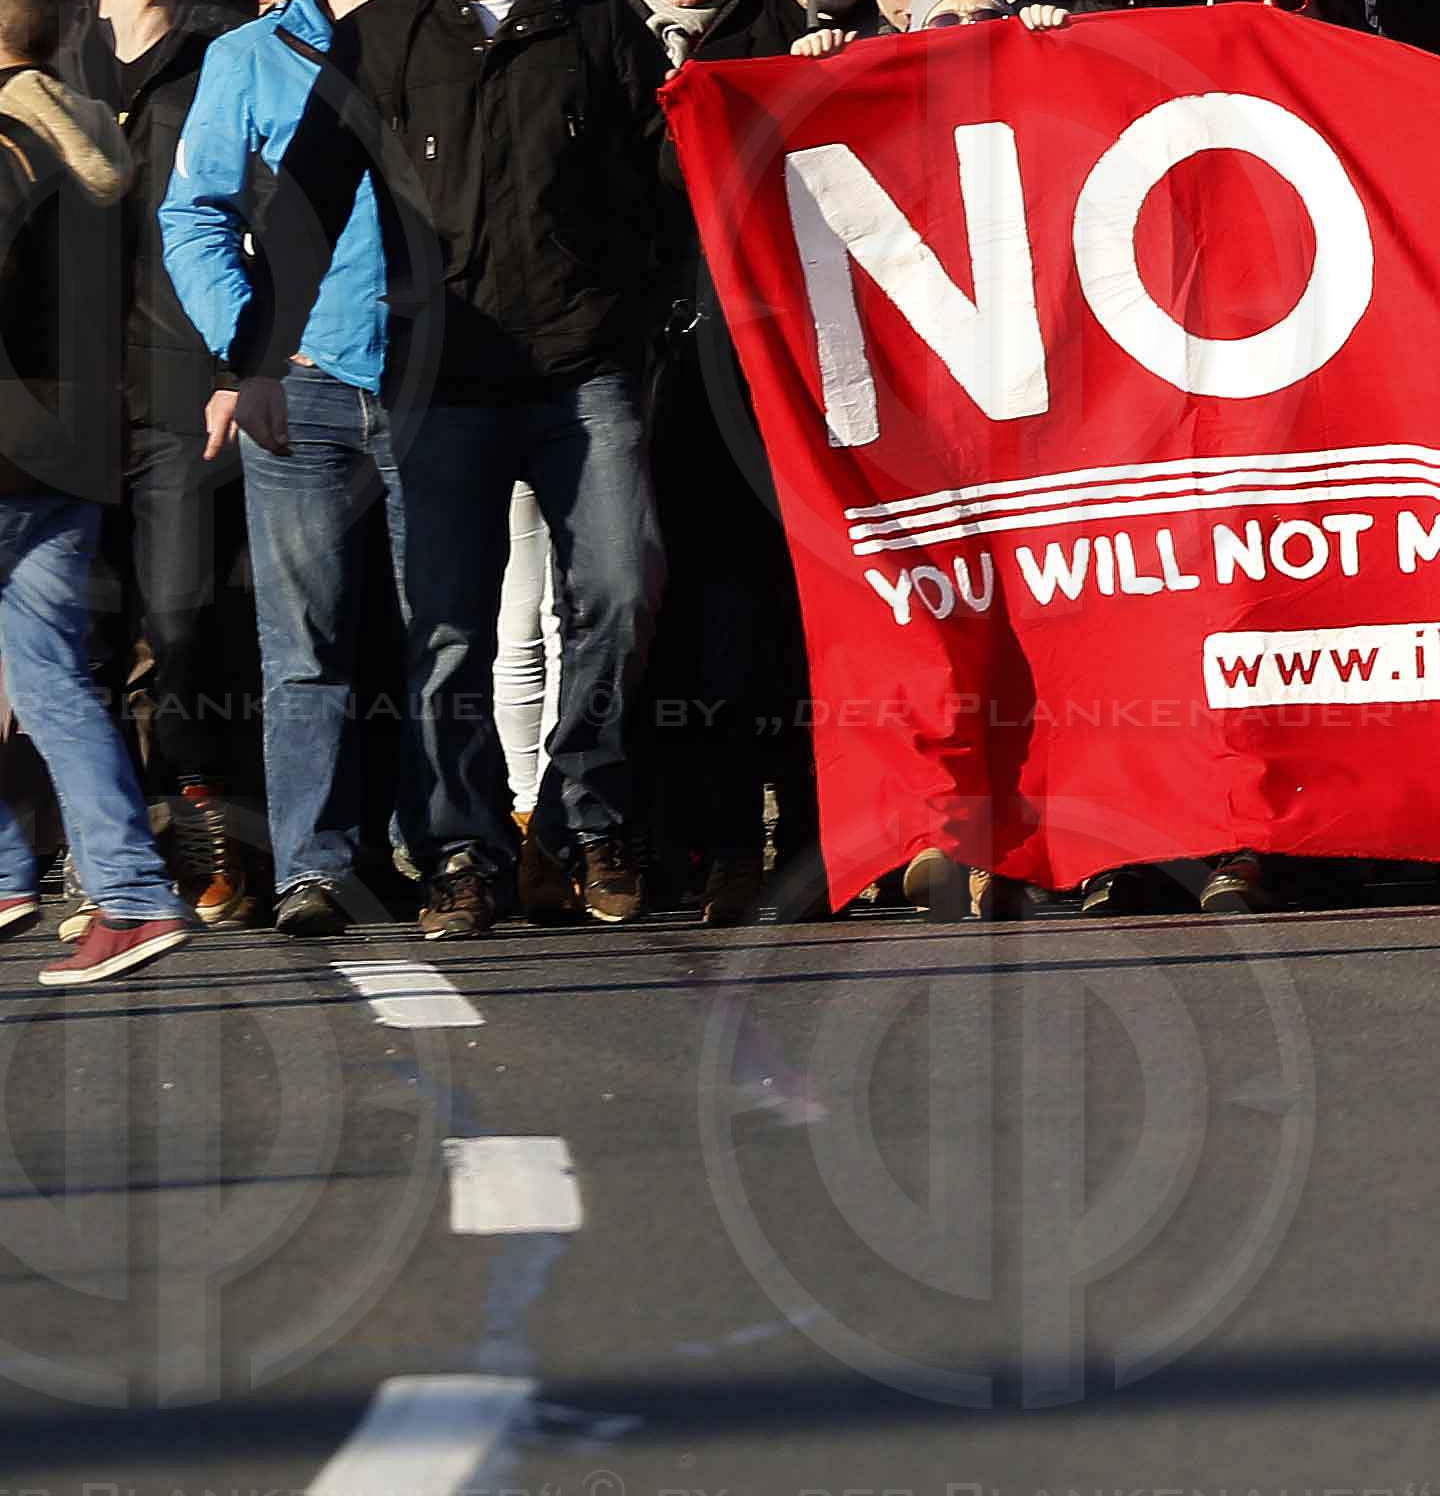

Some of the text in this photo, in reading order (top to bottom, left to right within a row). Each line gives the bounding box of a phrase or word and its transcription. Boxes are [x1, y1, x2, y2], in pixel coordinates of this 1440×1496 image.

[785, 91, 1375, 448] NO
[863, 552, 994, 625] YOU
[1015, 528, 1201, 606] WILL
[1212, 512, 1375, 585] NOT
